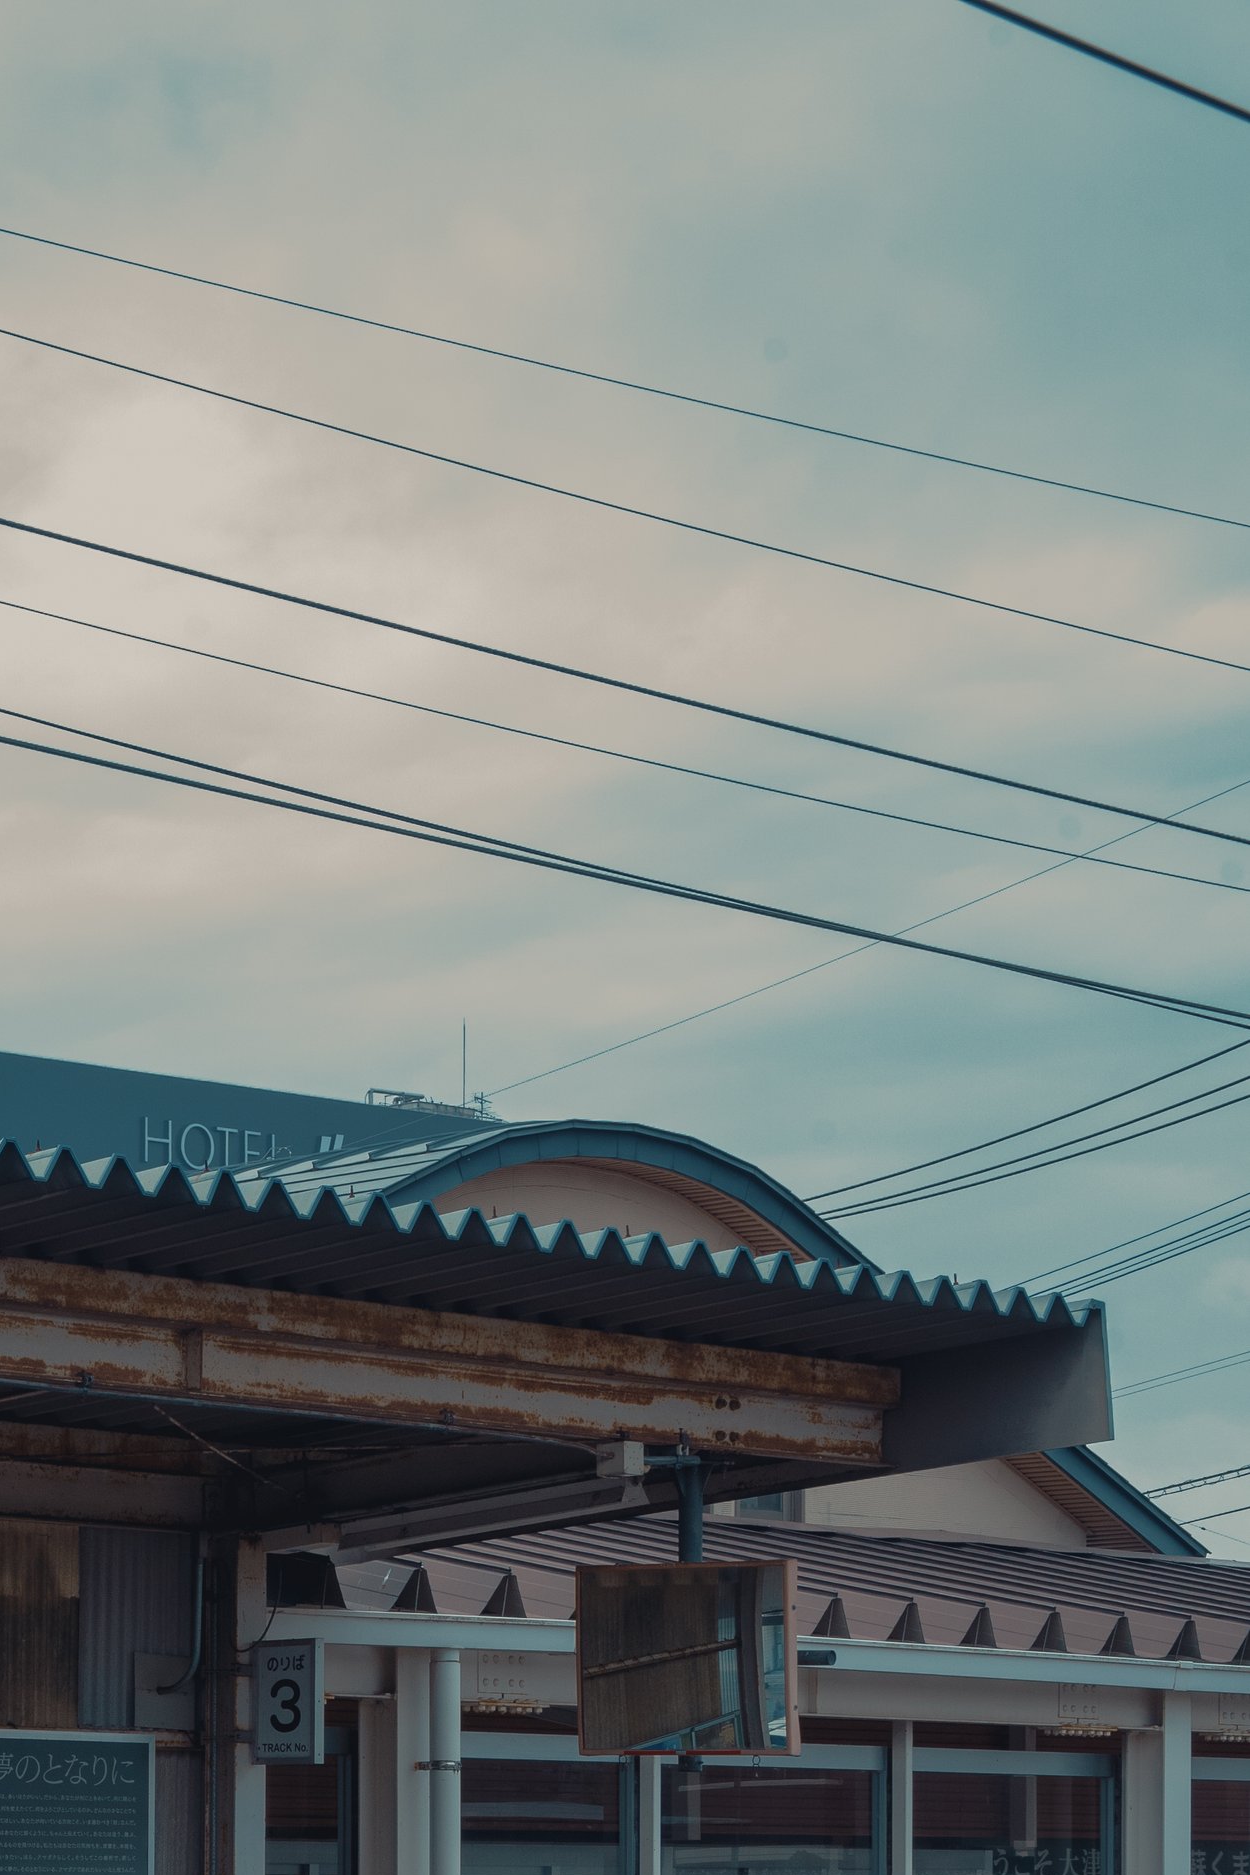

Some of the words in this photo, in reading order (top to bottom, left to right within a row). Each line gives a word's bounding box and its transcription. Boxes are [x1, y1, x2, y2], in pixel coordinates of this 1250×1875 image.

[267, 1654, 305, 1672] のりば
[270, 1679, 301, 1733] 3
[262, 1743, 292, 1753] TRACK
[294, 1743, 309, 1753] No.
